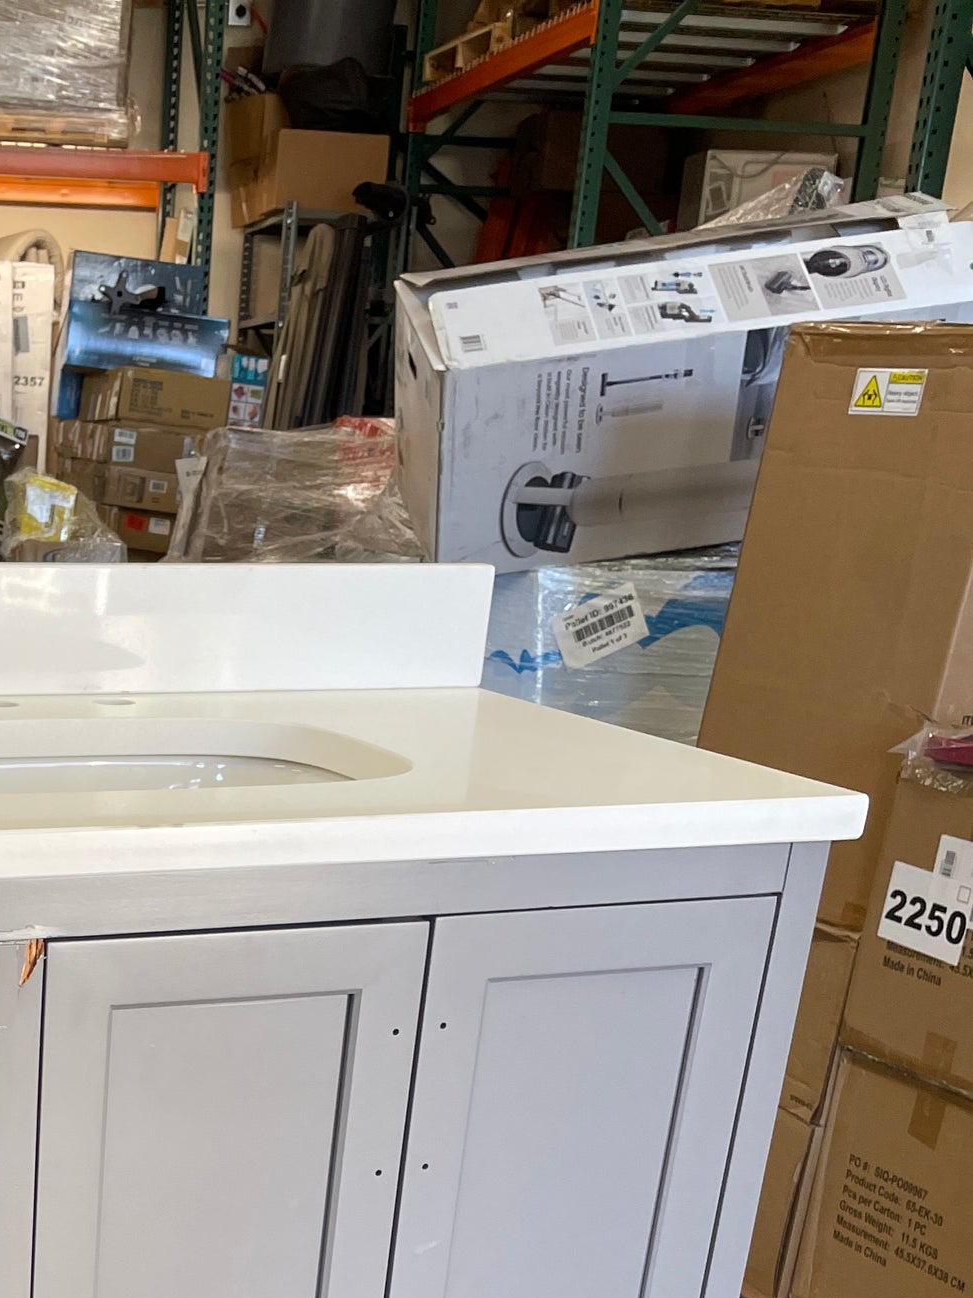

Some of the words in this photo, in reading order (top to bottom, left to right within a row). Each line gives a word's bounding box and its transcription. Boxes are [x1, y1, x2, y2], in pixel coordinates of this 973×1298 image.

[13, 375, 45, 387] 2357
[578, 367, 590, 407] Designed
[577, 420, 585, 430] be
[578, 408, 586, 418] to
[565, 615, 589, 630] Pallet
[589, 609, 602, 618] ID:
[592, 642, 609, 652] Pallet
[885, 889, 967, 945] 2250
[883, 956, 905, 974] Made
[906, 964, 915, 978] in
[916, 968, 942, 986] China
[849, 1154, 861, 1168] PO
[845, 1169, 876, 1193] Product
[878, 1186, 901, 1206] Code:
[842, 1184, 857, 1200] Pcs
[858, 1196, 871, 1208] per
[873, 1202, 903, 1224] Carton:
[907, 1218, 911, 1228] 1
[914, 1222, 927, 1236] PC
[839, 1200, 862, 1220] Gross
[865, 1213, 893, 1236] Weight:
[901, 1232, 917, 1248] 11.5
[919, 1242, 939, 1260] KGS
[833, 1230, 853, 1248] Made
[855, 1242, 862, 1254] in
[864, 1248, 887, 1267] China
[836, 1215, 889, 1250] Measurement:
[950, 1276, 965, 1292] CM
